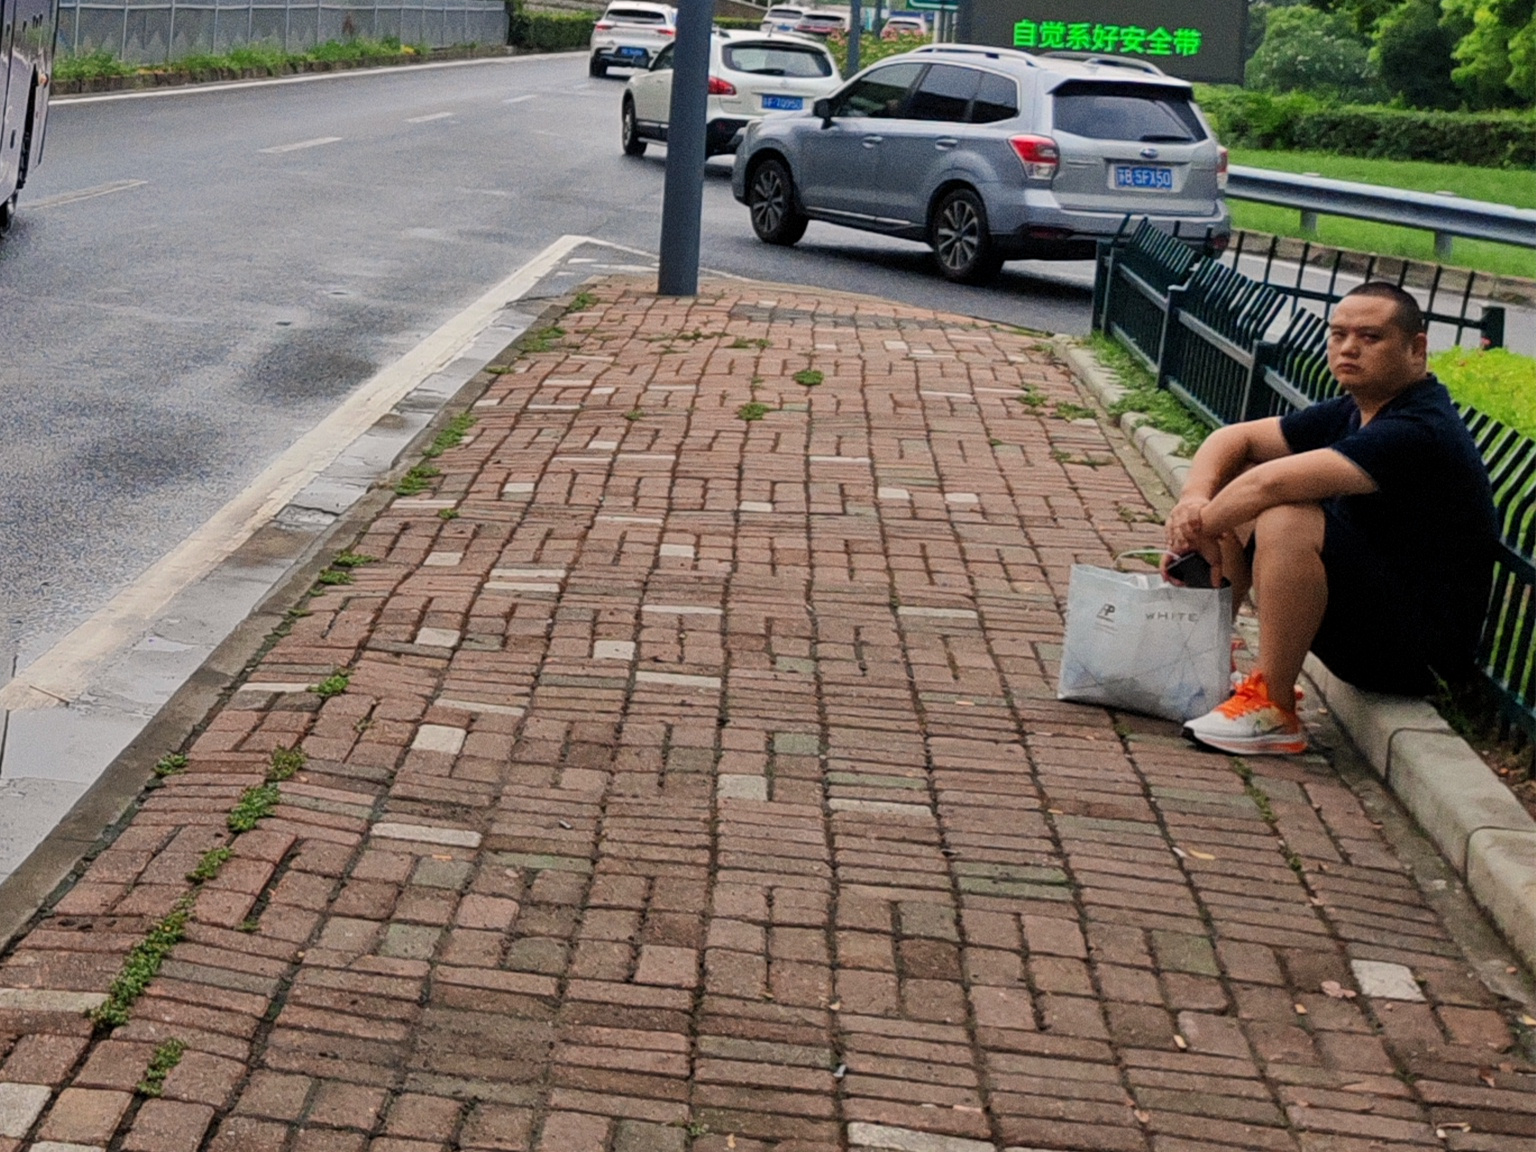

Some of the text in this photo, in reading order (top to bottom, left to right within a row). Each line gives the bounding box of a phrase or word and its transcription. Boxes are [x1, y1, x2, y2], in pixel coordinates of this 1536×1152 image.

[1013, 19, 1203, 56] 自觉系好安全带
